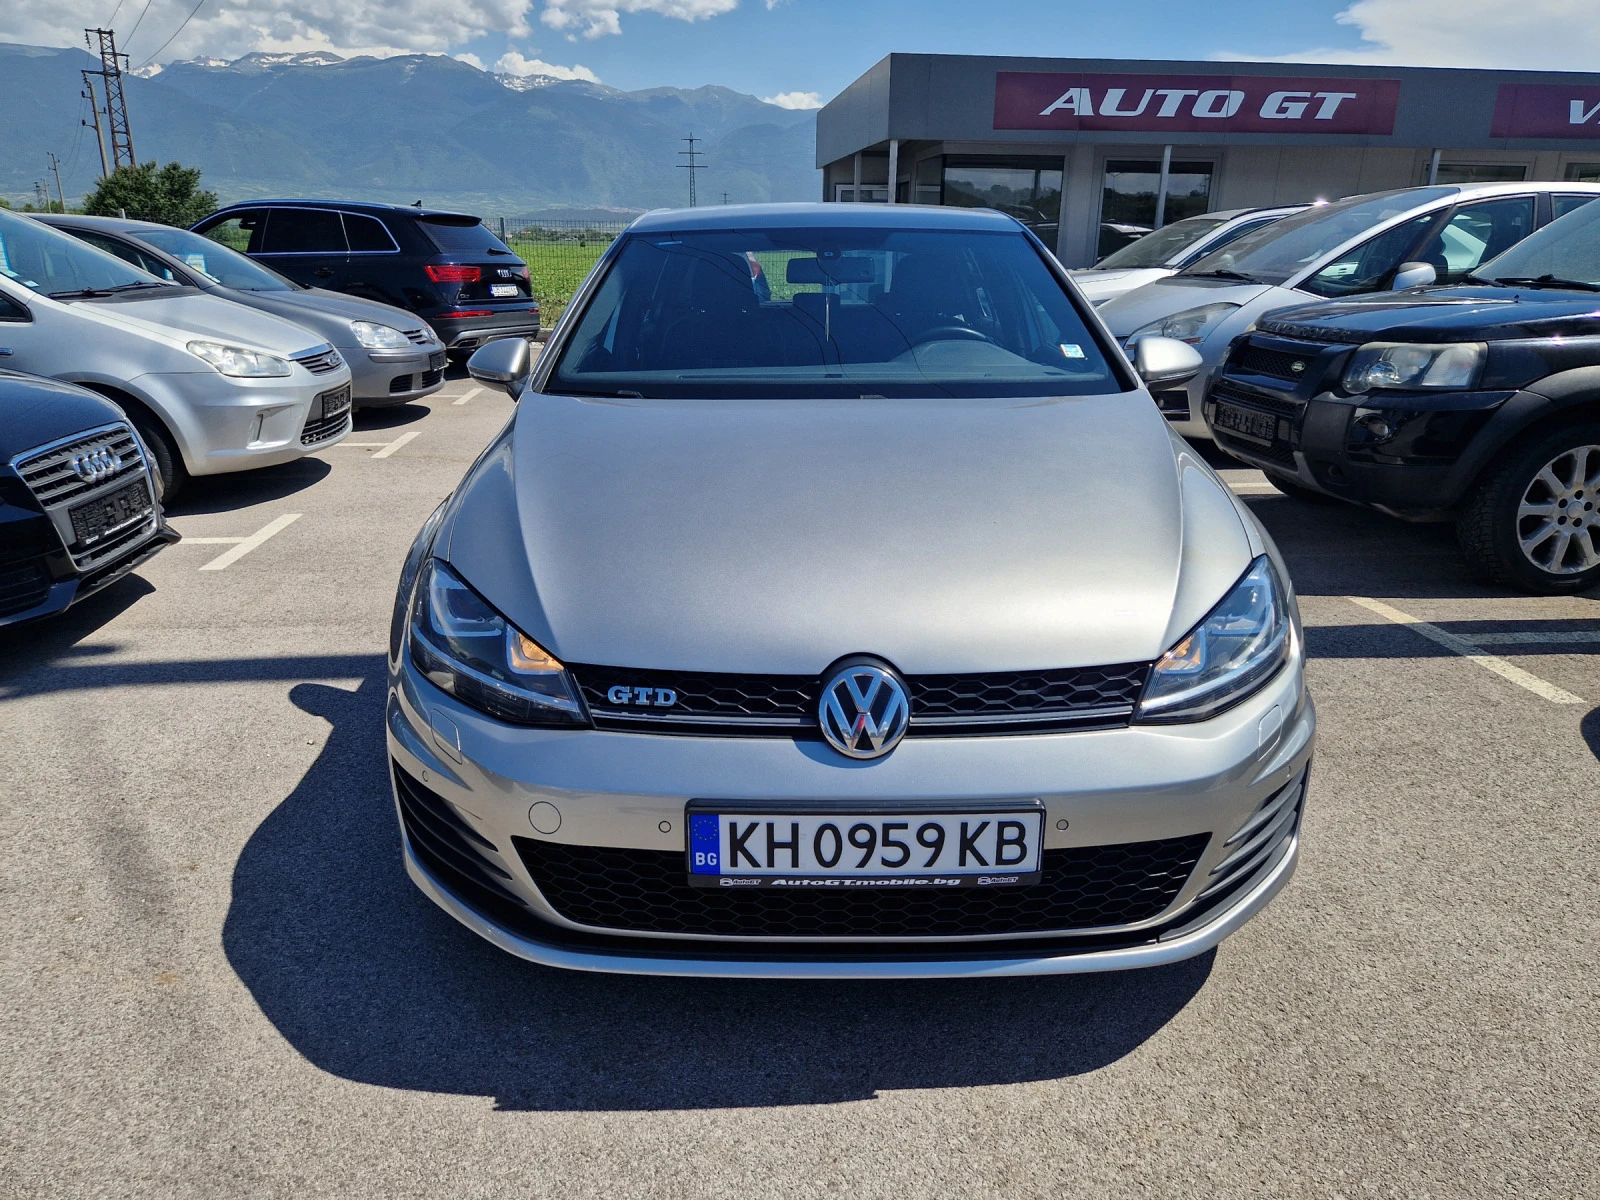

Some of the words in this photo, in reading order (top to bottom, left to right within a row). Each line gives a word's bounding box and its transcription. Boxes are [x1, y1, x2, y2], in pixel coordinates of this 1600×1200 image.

[1038, 87, 1245, 118] AUTO
[1259, 91, 1357, 120] GT
[1569, 99, 1600, 124] V
[607, 685, 678, 706] GTD
[819, 665, 909, 759] VW
[695, 852, 718, 866] BG
[771, 878, 961, 887] AutoGT.mobile.bg
